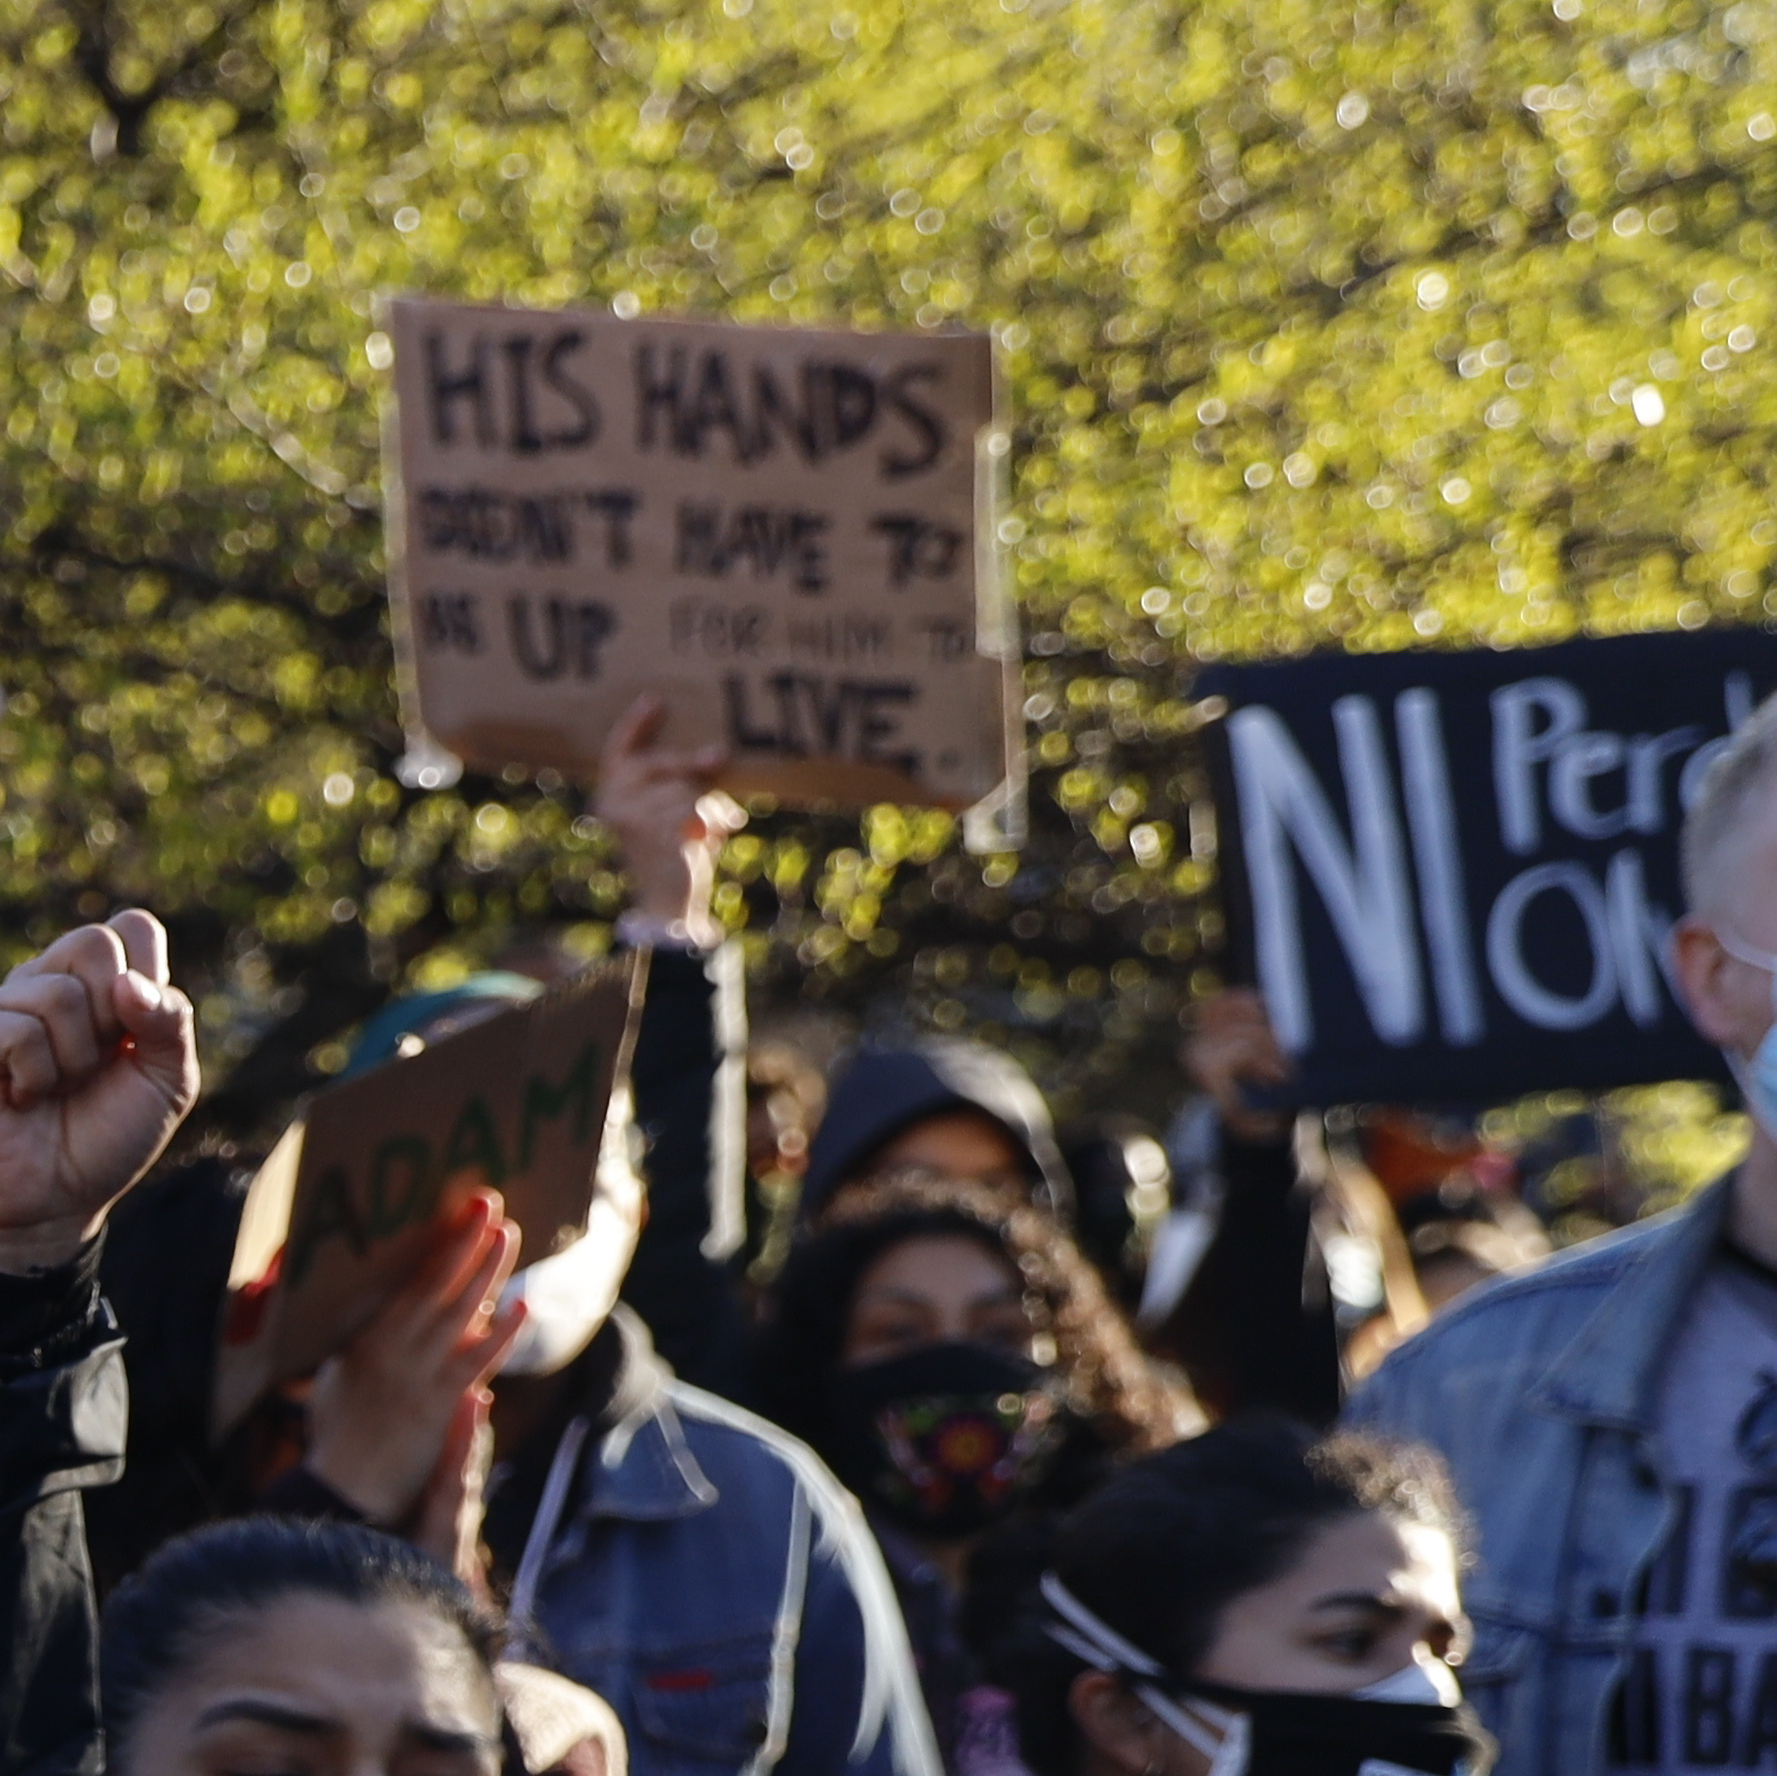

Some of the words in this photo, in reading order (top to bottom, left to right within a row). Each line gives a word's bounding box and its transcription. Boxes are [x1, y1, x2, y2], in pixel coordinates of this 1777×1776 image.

[421, 328, 602, 458] HIS
[633, 342, 947, 482] HANDS
[869, 510, 965, 588] TO
[503, 592, 623, 684] UP
[284, 1038, 605, 1290] ADAM
